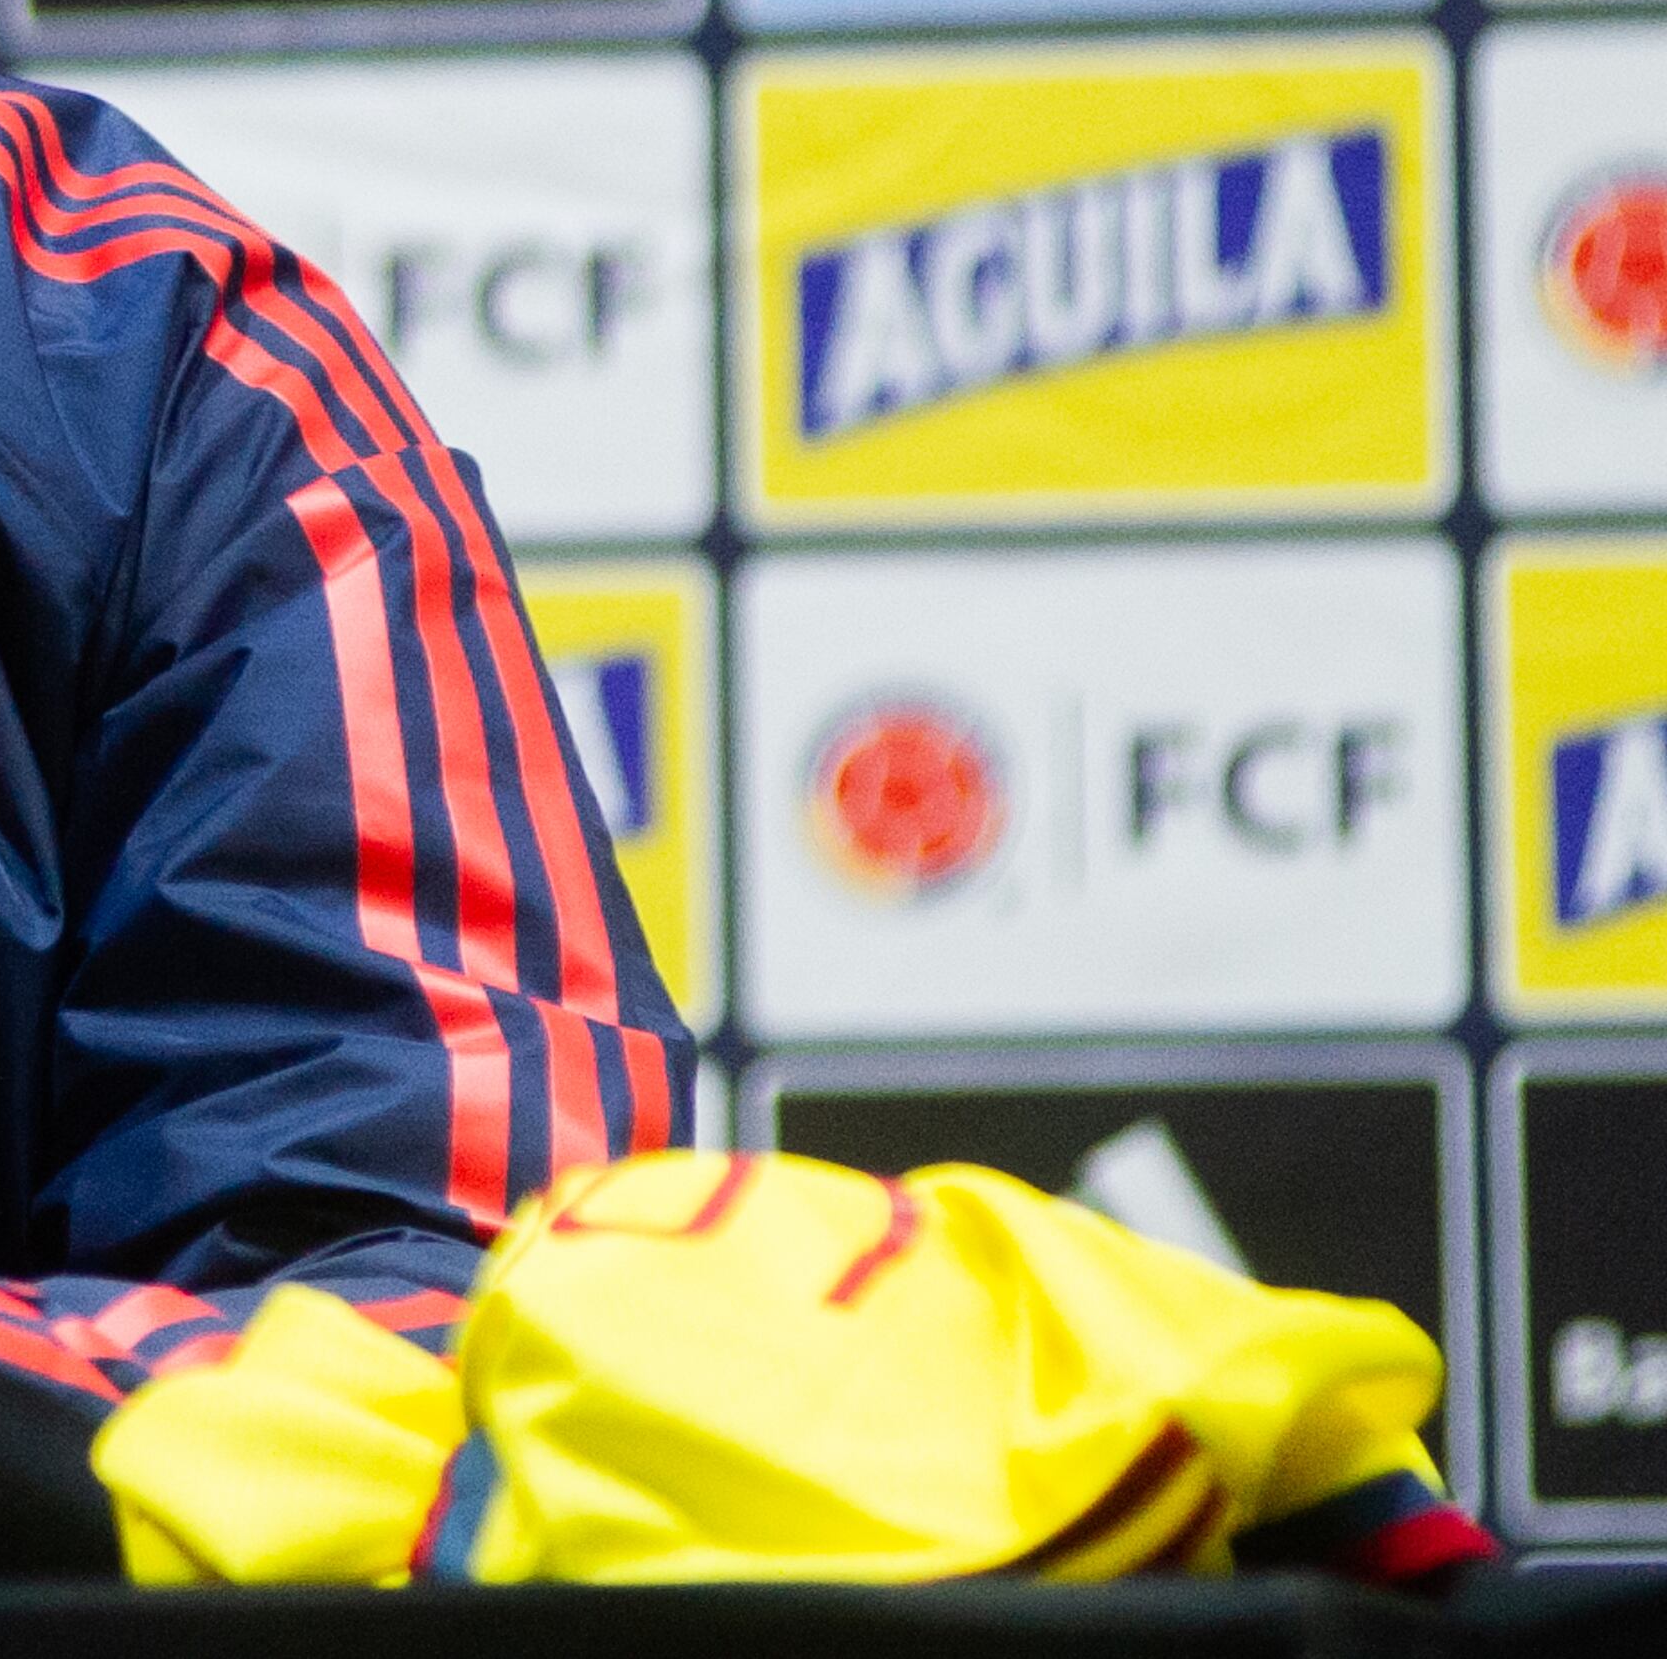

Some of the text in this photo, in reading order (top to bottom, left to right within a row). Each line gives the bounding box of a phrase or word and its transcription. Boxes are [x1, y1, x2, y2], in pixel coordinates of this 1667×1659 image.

[382, 238, 649, 360] FCF
[812, 138, 1377, 432] AGUILA
[1127, 724, 1405, 850] FCF
